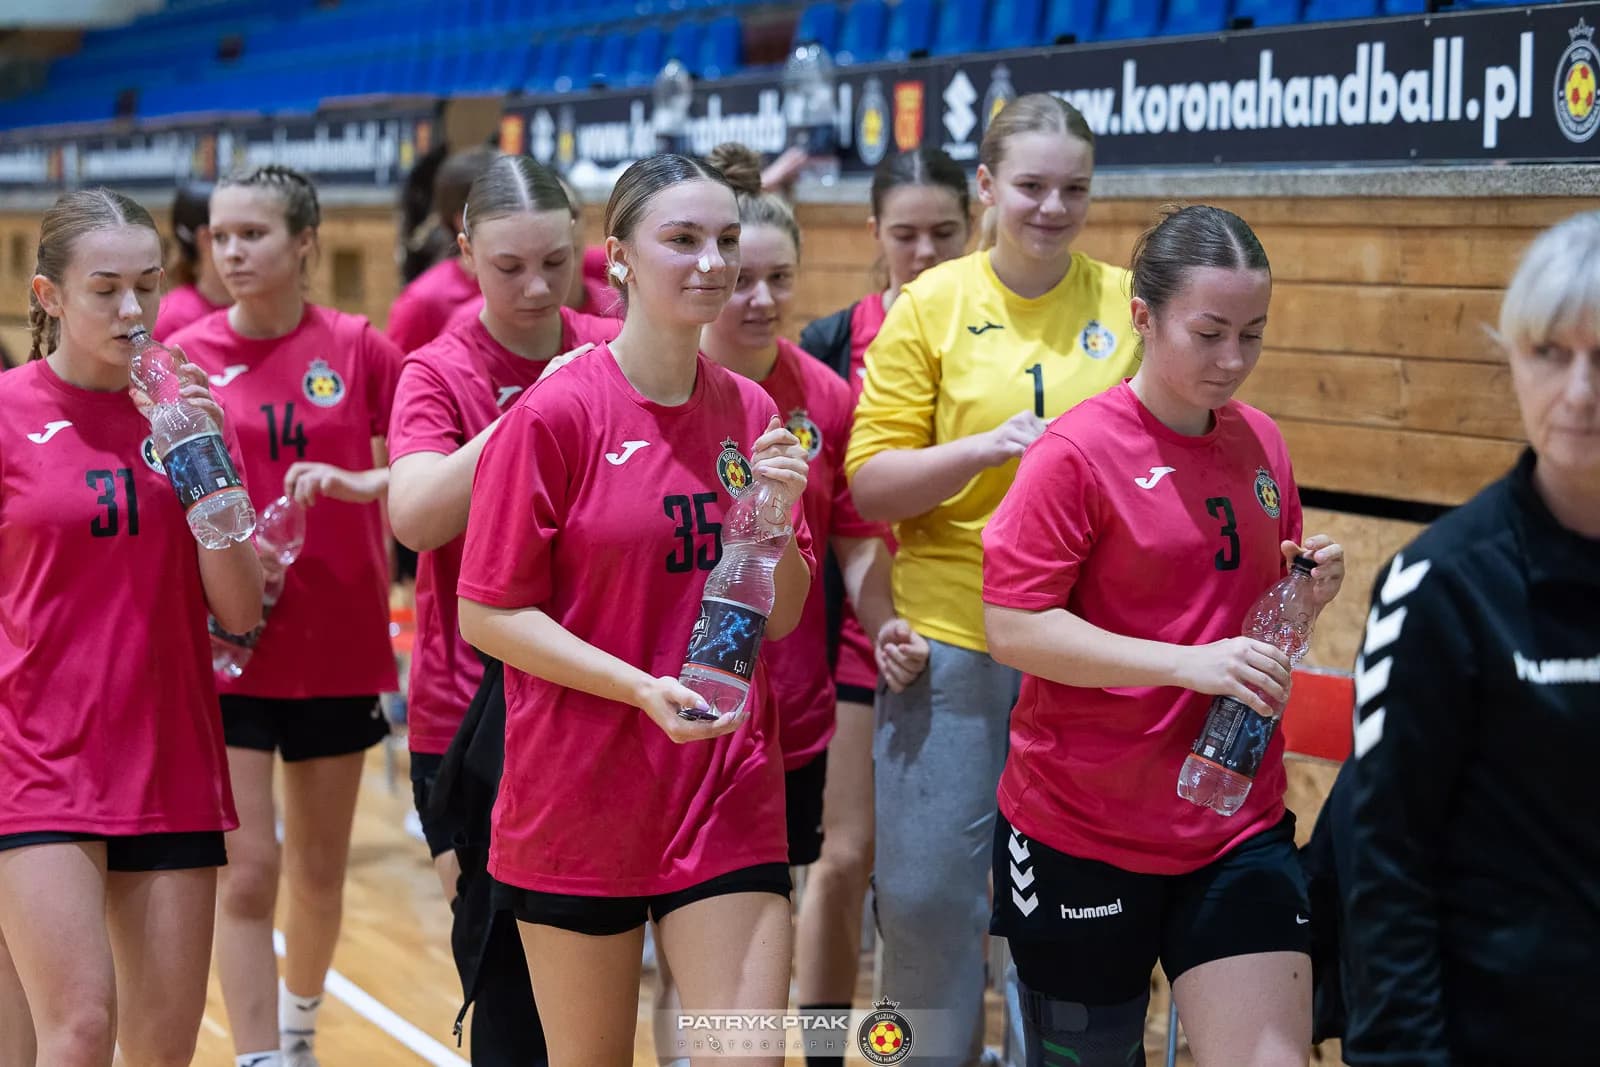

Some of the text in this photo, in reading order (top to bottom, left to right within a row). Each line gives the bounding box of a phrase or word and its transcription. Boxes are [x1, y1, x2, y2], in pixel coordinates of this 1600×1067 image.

[1048, 32, 1534, 149] w.koronahandball.pl
[1025, 363, 1044, 417] 1
[260, 402, 308, 461] 14
[86, 467, 139, 538] 31
[663, 492, 722, 573] 35
[1205, 496, 1240, 571] 3
[1060, 898, 1123, 920] hummel
